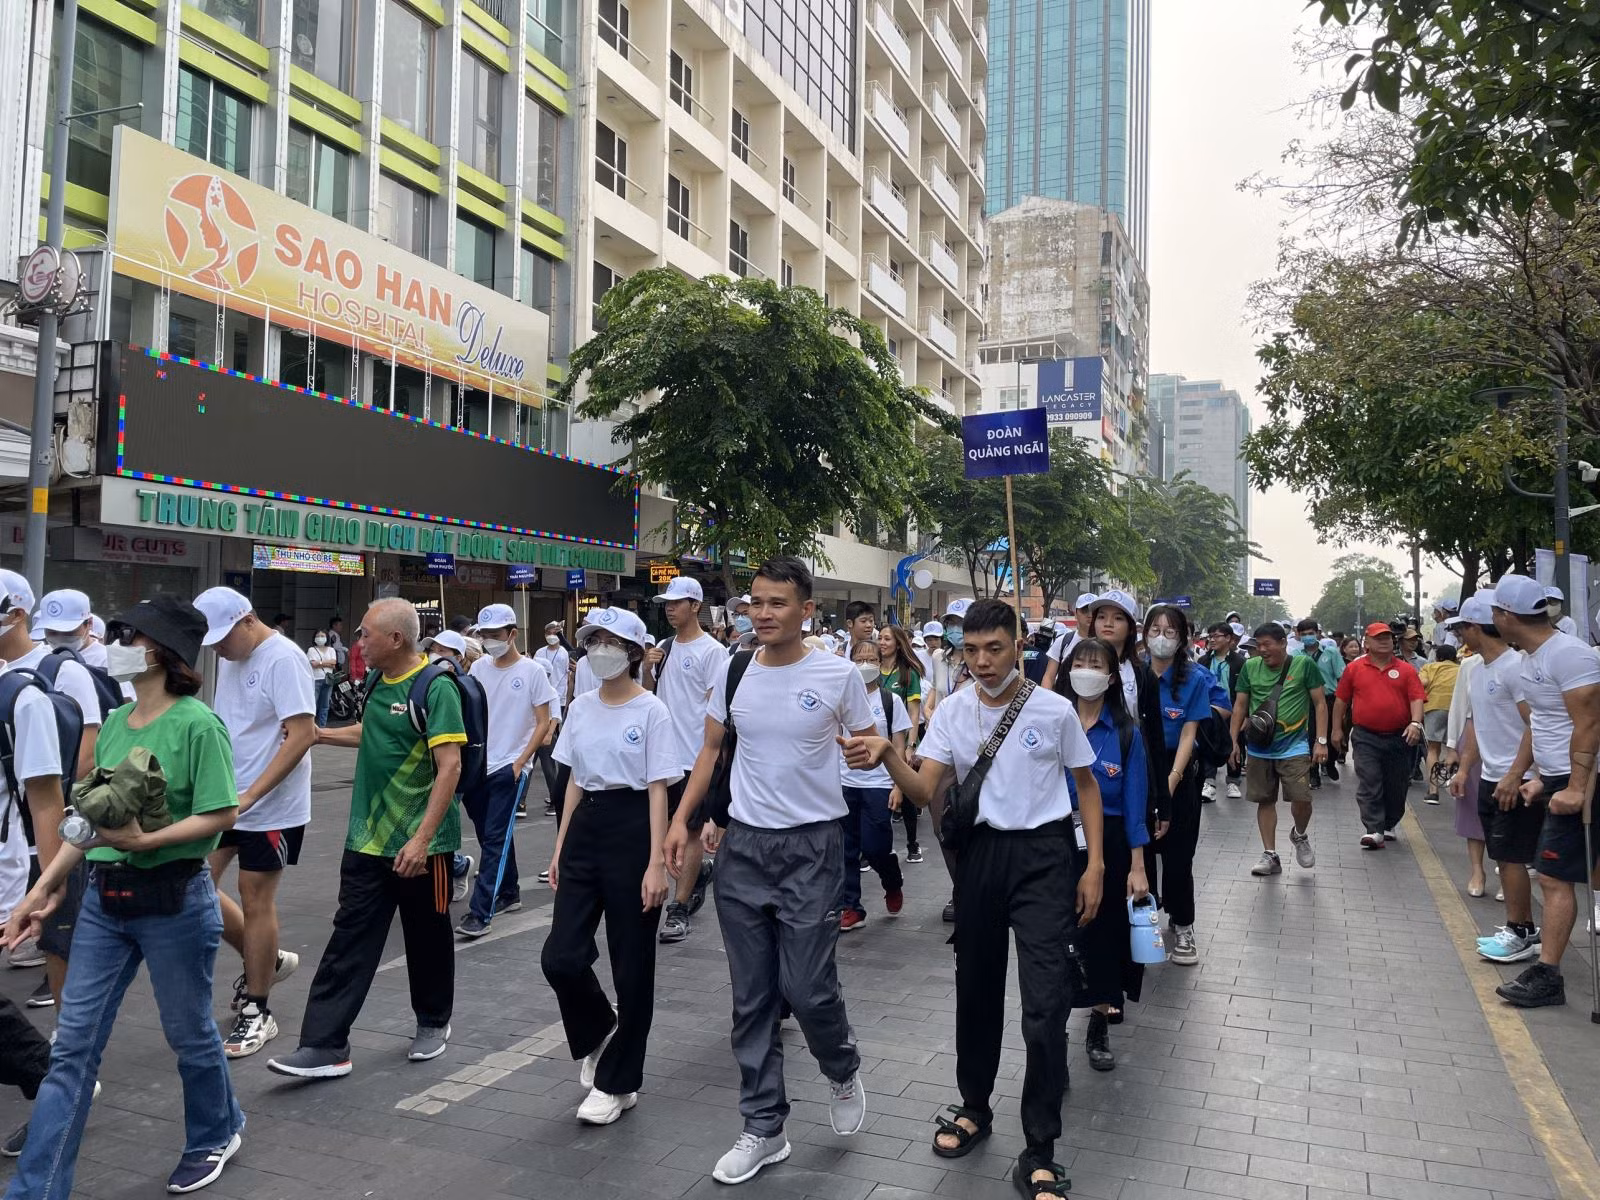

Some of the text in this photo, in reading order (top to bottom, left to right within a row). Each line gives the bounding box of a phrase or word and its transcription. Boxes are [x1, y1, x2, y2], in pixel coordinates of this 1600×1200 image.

[274, 223, 453, 327] SAO HAN
[298, 282, 431, 351] HOSPITAL
[456, 301, 525, 380] Deluxe
[1041, 392, 1096, 403] LANCASTER
[1045, 402, 1092, 410] LEGACY
[1065, 411, 1093, 421] 090909
[986, 426, 1022, 440] ĐOÀN
[968, 441, 1044, 461] QUẢNG NGÃI
[136, 488, 238, 531] TRUNG
[244, 501, 300, 539] TÂM
[306, 512, 361, 545] GIAO
[365, 519, 417, 552] DỊCH
[419, 525, 455, 554] BẤT
[132, 537, 187, 556] CUTS
